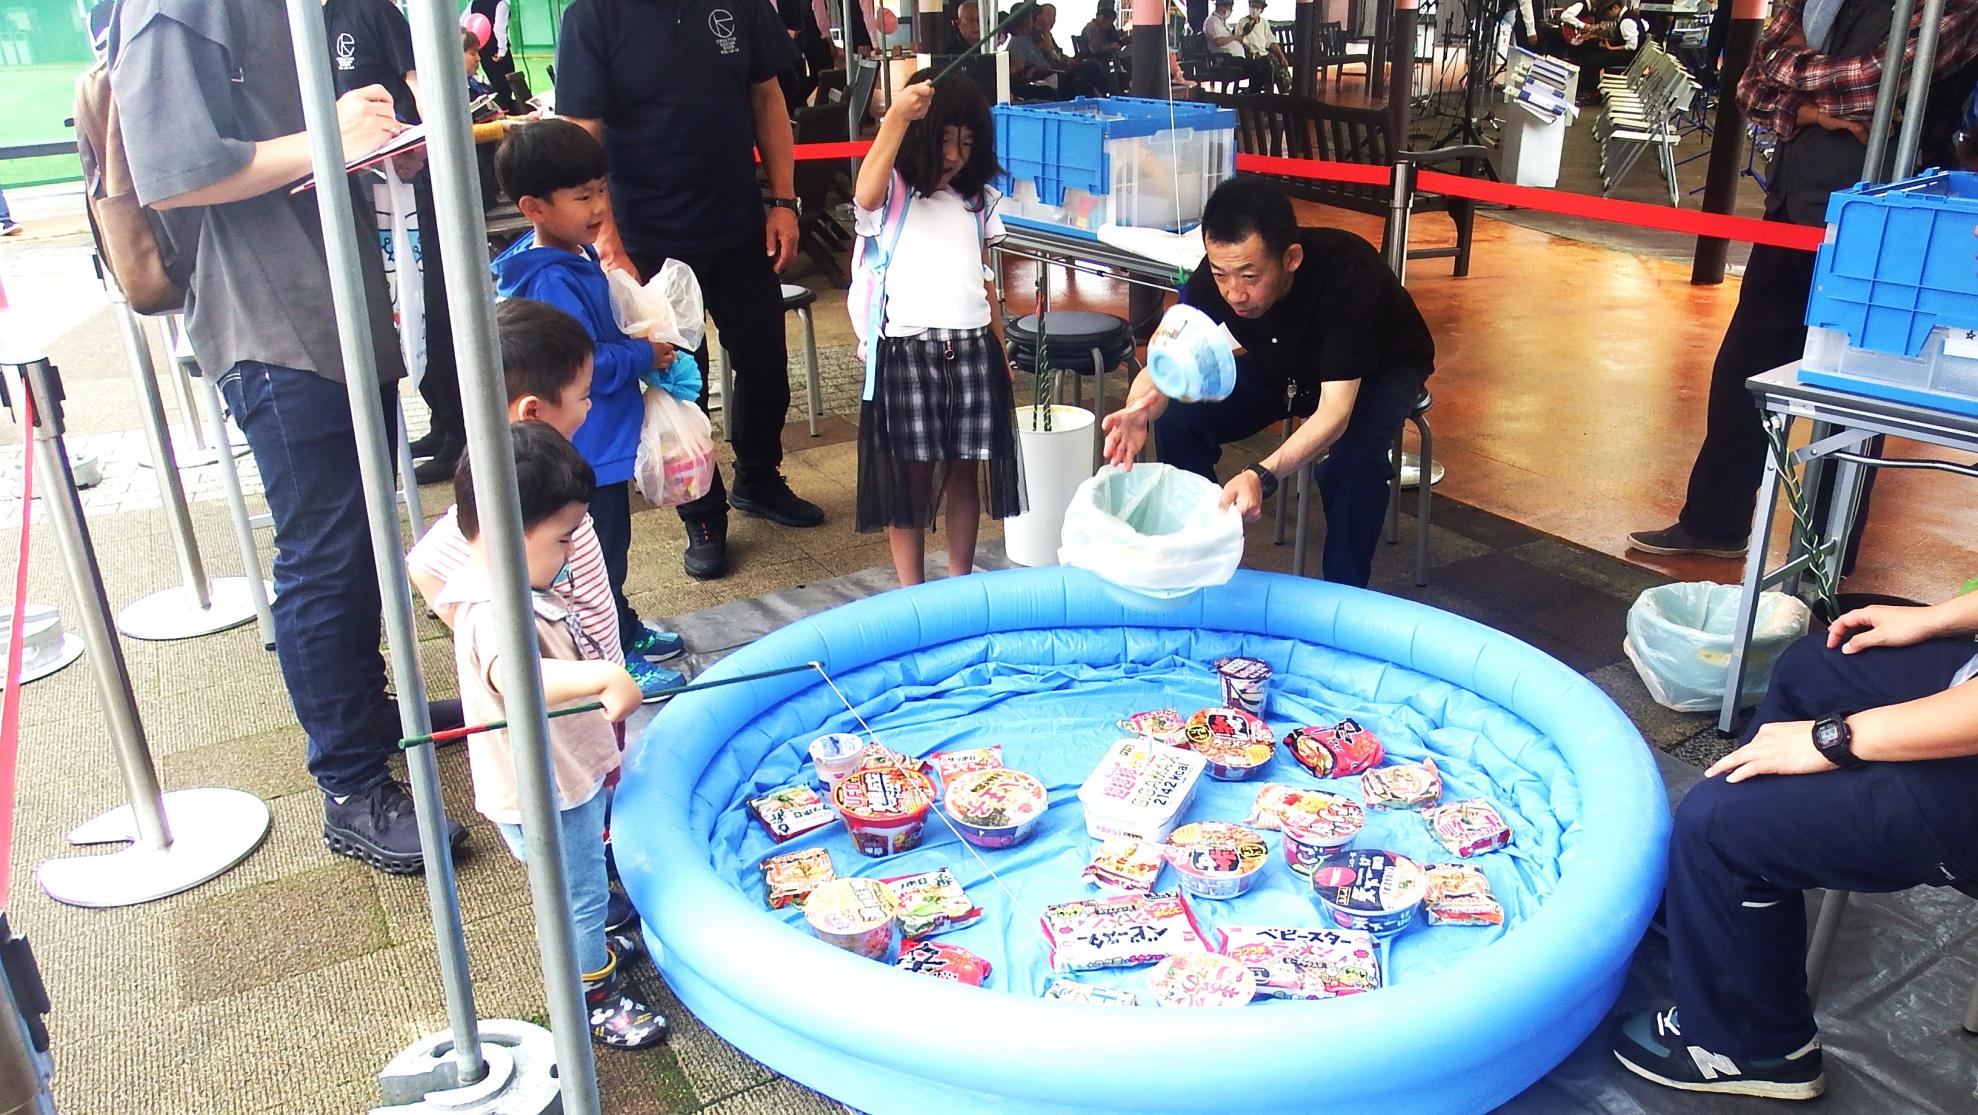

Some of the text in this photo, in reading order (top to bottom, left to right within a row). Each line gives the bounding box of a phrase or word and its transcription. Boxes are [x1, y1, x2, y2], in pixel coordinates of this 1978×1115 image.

[1077, 925, 1168, 949] ベビースター
[1256, 928, 1352, 946] ベビースター
